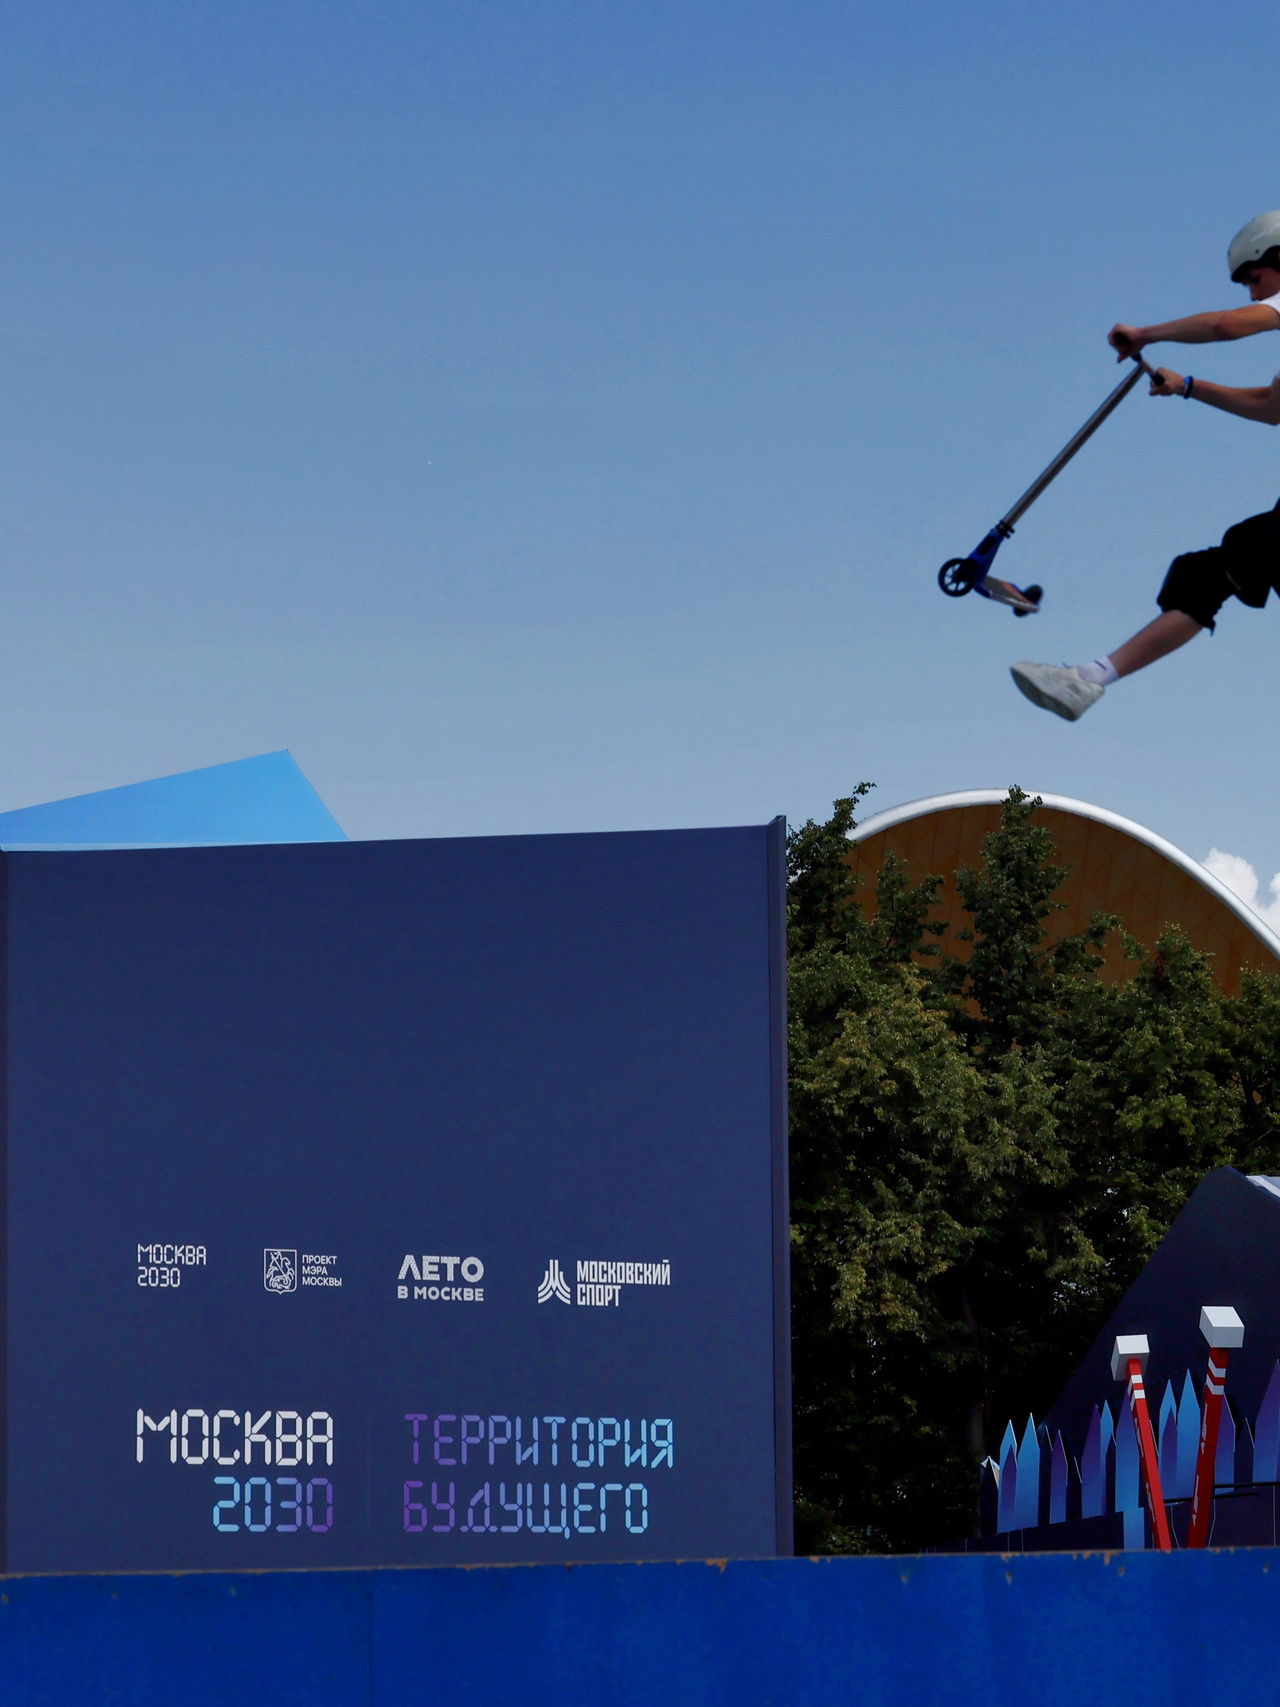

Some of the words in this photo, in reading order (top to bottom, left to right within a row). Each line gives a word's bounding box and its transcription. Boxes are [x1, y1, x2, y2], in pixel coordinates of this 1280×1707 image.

[137, 1243, 207, 1266] МОСКВА
[302, 1254, 337, 1265] ПРОЕКТ
[137, 1266, 181, 1288] 2030
[302, 1265, 328, 1276] МЭРА
[397, 1254, 484, 1283] ЛЕТО
[576, 1259, 671, 1285] МОСКОВСКИЙ
[302, 1276, 342, 1287] МОСКВЫ
[397, 1285, 409, 1299] В
[413, 1286, 484, 1301] МОСКВЕ
[577, 1284, 621, 1307] СПОРТ
[136, 1408, 334, 1466] МОСКВА
[404, 1413, 674, 1468] ТЕРРИТОРИЯ
[212, 1476, 334, 1532] 2030
[403, 1480, 649, 1540] БУДУЩЕГО
